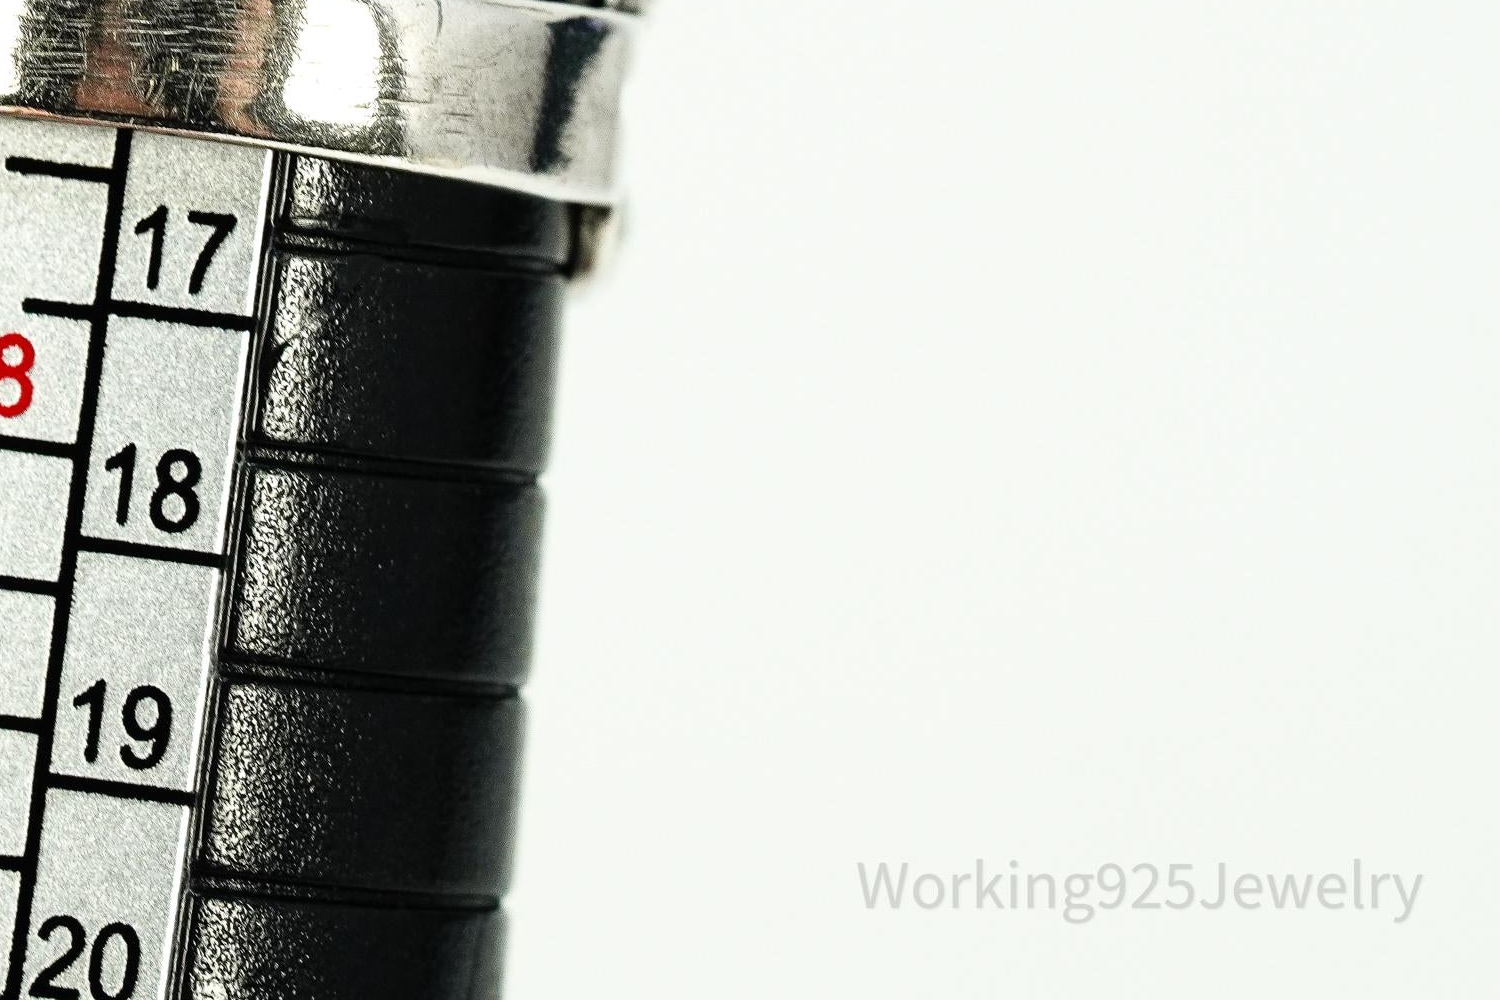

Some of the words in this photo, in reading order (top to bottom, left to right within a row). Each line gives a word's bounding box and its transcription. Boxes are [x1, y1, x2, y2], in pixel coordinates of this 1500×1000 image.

[135, 204, 237, 296] 17
[105, 443, 202, 534] 18
[73, 679, 173, 771] 19
[28, 915, 142, 1000] 20
